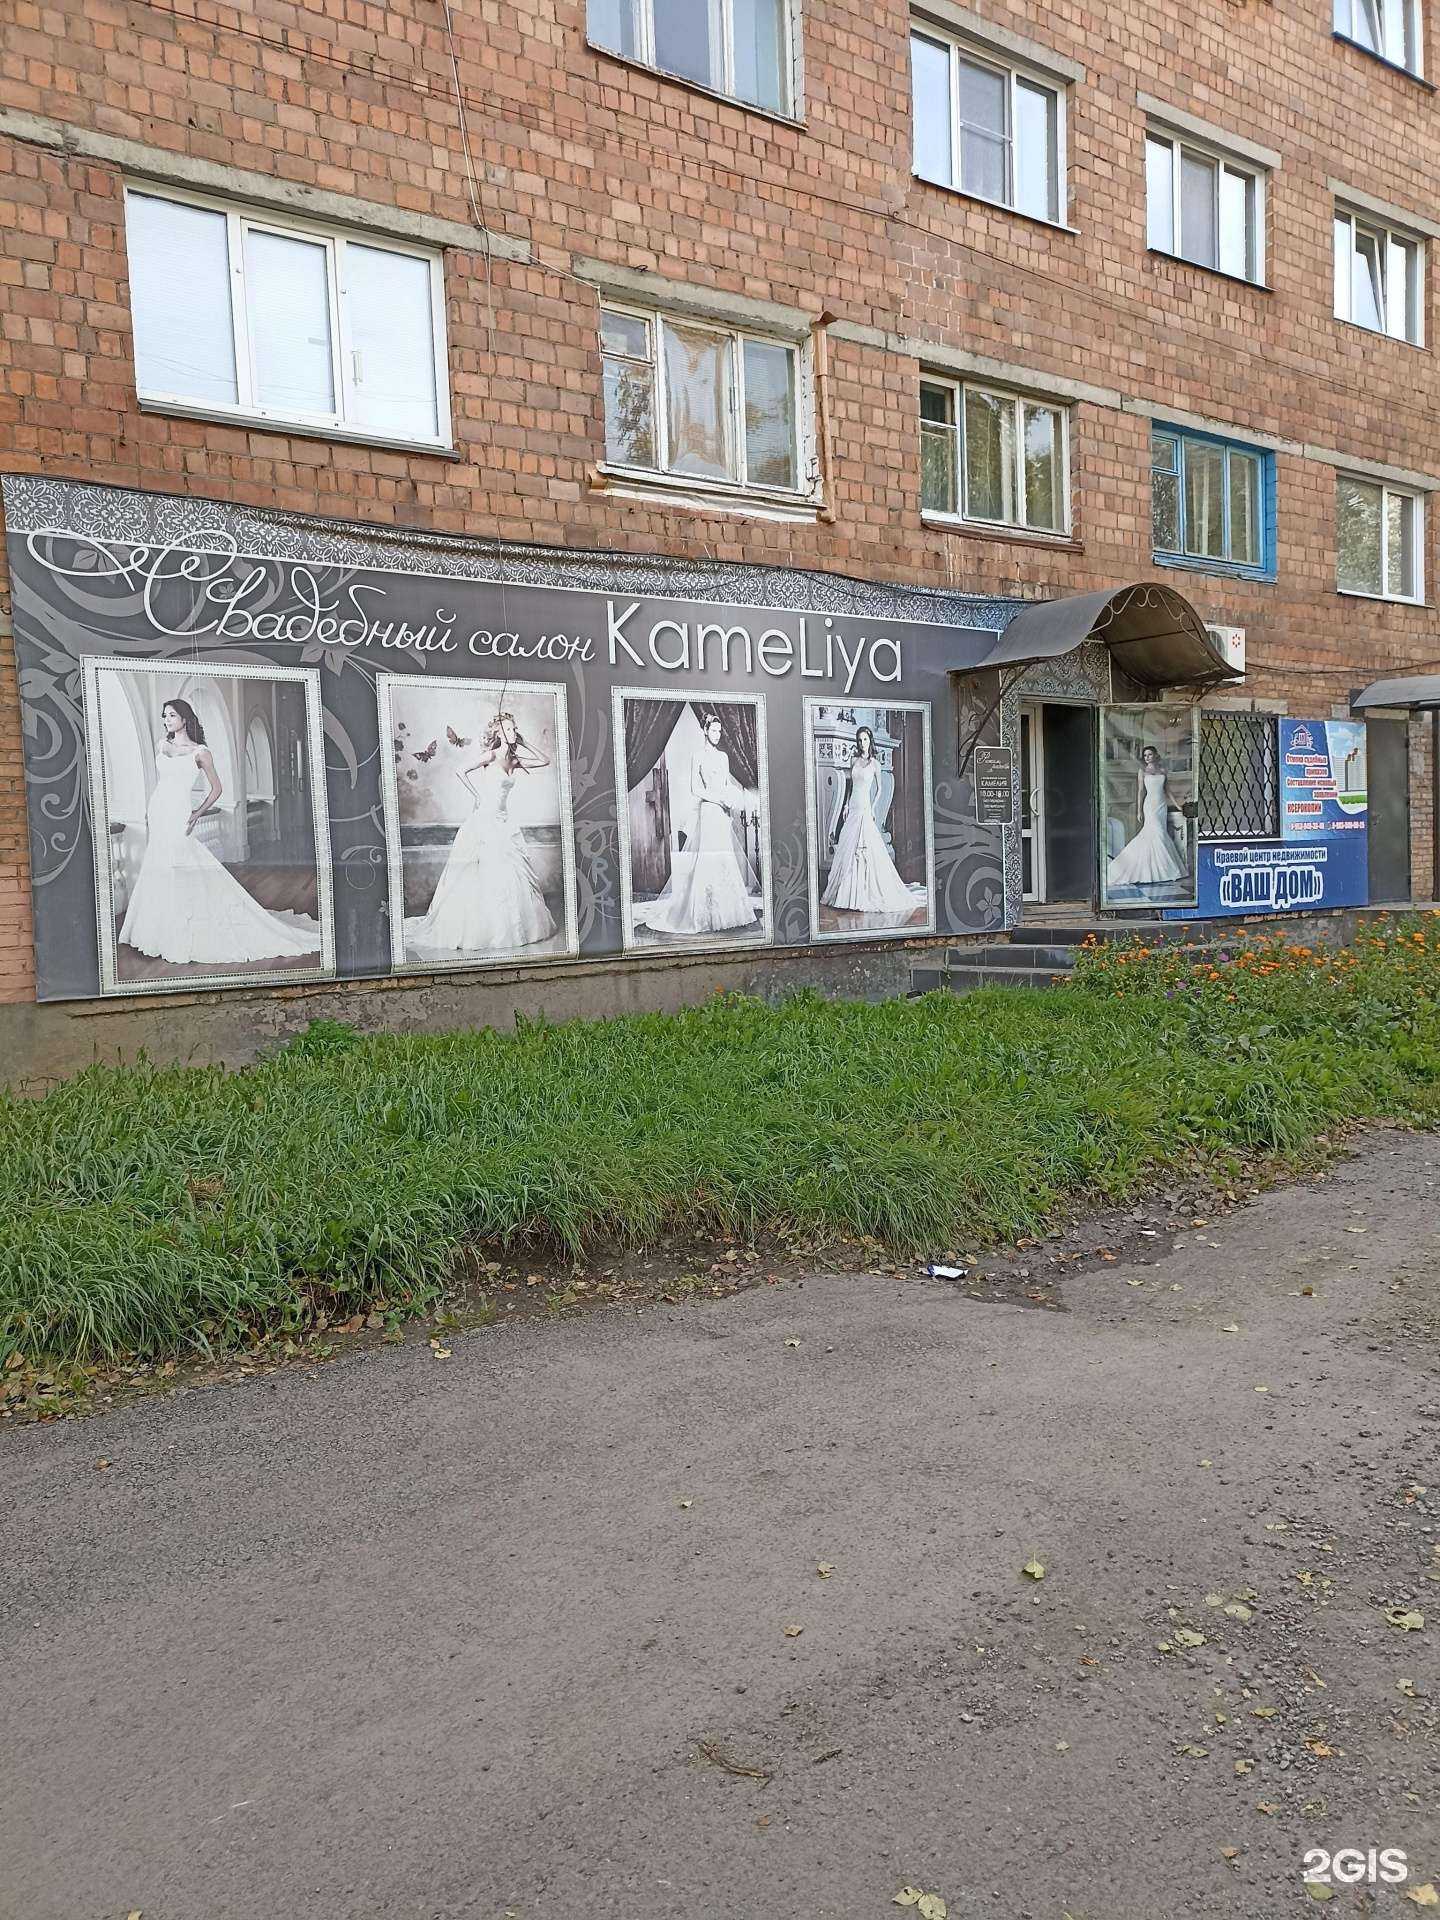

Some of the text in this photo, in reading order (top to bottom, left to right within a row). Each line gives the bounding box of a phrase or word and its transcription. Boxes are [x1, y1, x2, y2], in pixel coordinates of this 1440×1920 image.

[27, 529, 598, 662] Свадебный салон
[606, 600, 903, 694] KameLiya
[1215, 848, 1326, 864] Краевой центр недвижимости
